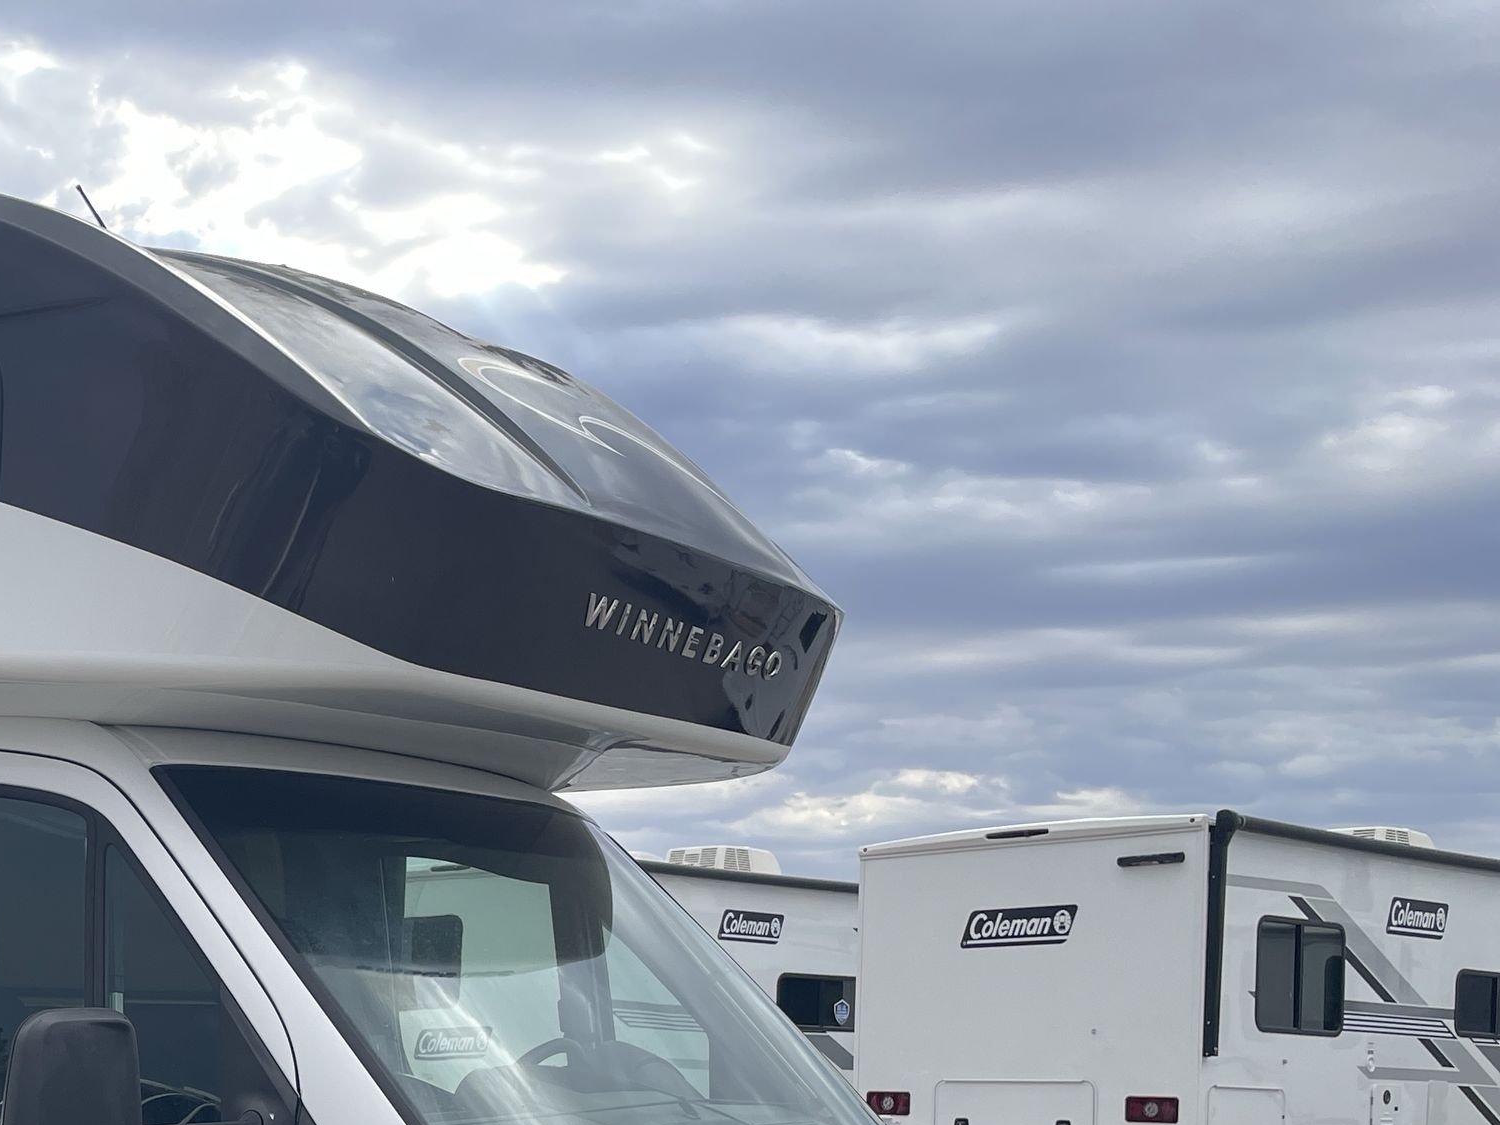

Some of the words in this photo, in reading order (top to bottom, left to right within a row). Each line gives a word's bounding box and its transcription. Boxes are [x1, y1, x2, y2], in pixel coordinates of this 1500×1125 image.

[584, 592, 782, 681] WINNEBAGO
[723, 911, 770, 936] Coleman
[969, 912, 1052, 940] Coleman
[1391, 900, 1436, 929] Coleman
[419, 1031, 475, 1053] Coleman
